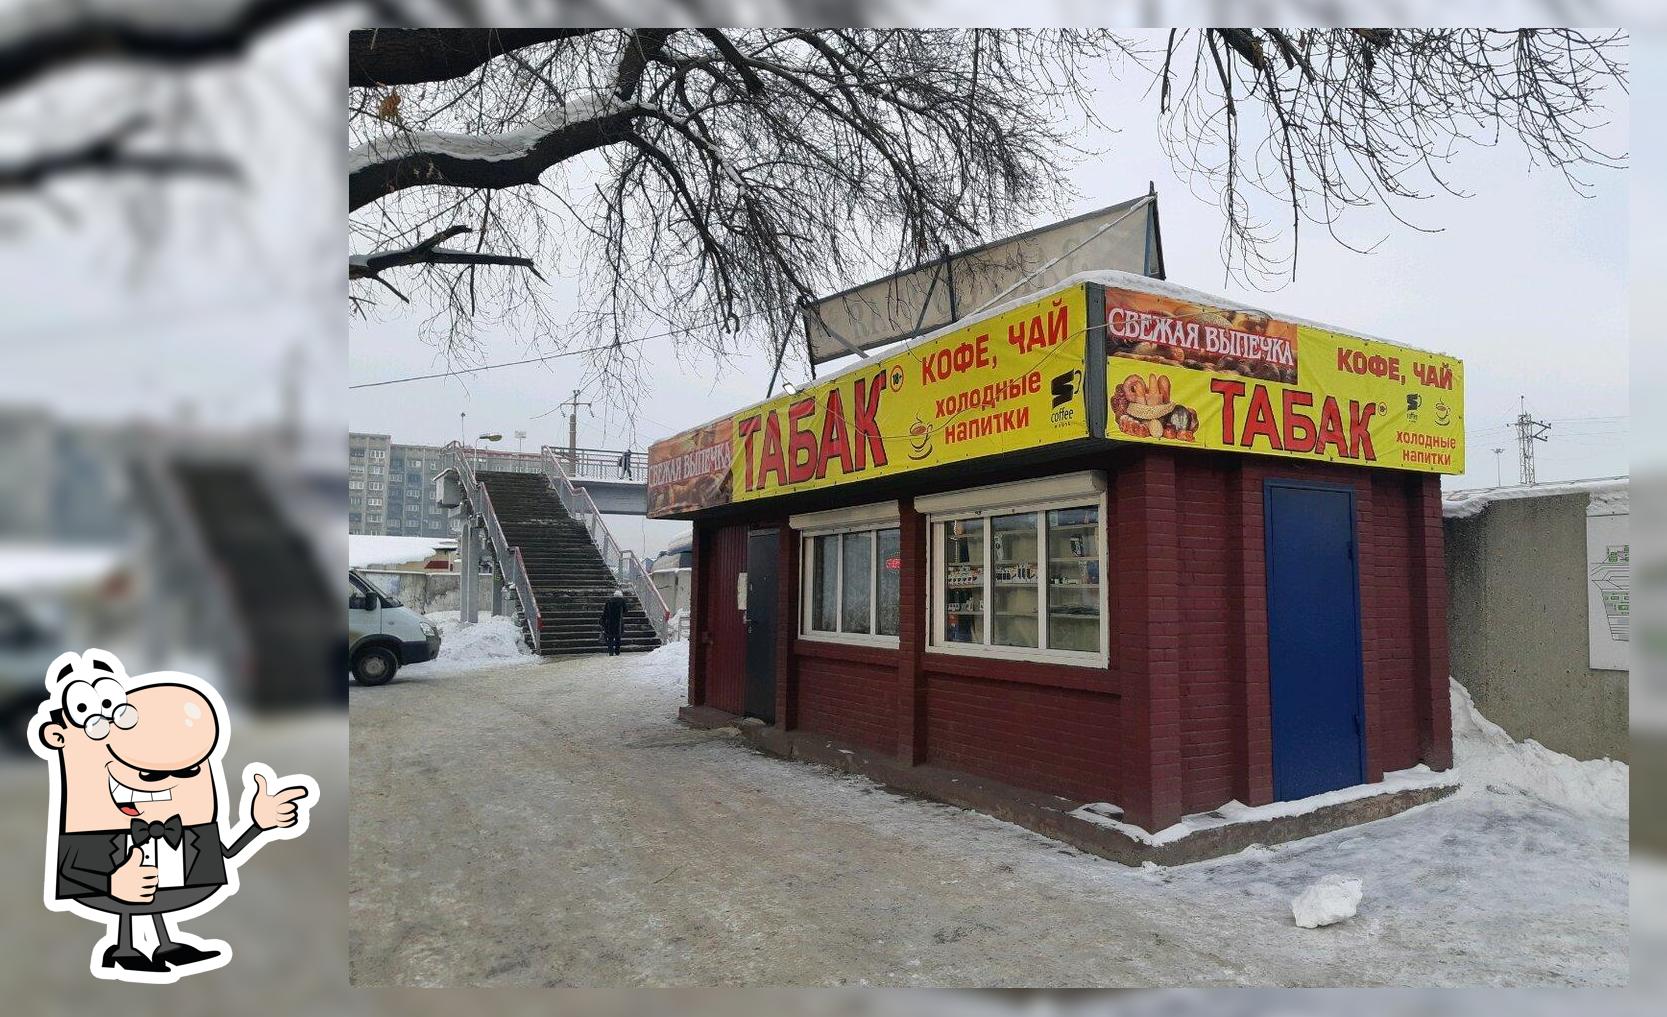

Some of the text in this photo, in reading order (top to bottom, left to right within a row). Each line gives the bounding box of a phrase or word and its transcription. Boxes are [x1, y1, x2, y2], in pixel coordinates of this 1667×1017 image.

[921, 333, 997, 386] КОФЕ,
[1008, 298, 1068, 355] ЧАЙ
[1108, 307, 1294, 366] СВЕЖАЯ ВЫПЕЧКА
[1337, 347, 1453, 391] КОФЕ, ЧАЙ
[935, 371, 1041, 418] холодные
[1050, 407, 1074, 423] coffee
[739, 369, 888, 492] ТАБАК
[944, 406, 1029, 445] напитки
[1210, 377, 1377, 462] ТАБАК
[1396, 431, 1456, 449] холодные
[1403, 449, 1451, 466] напитки
